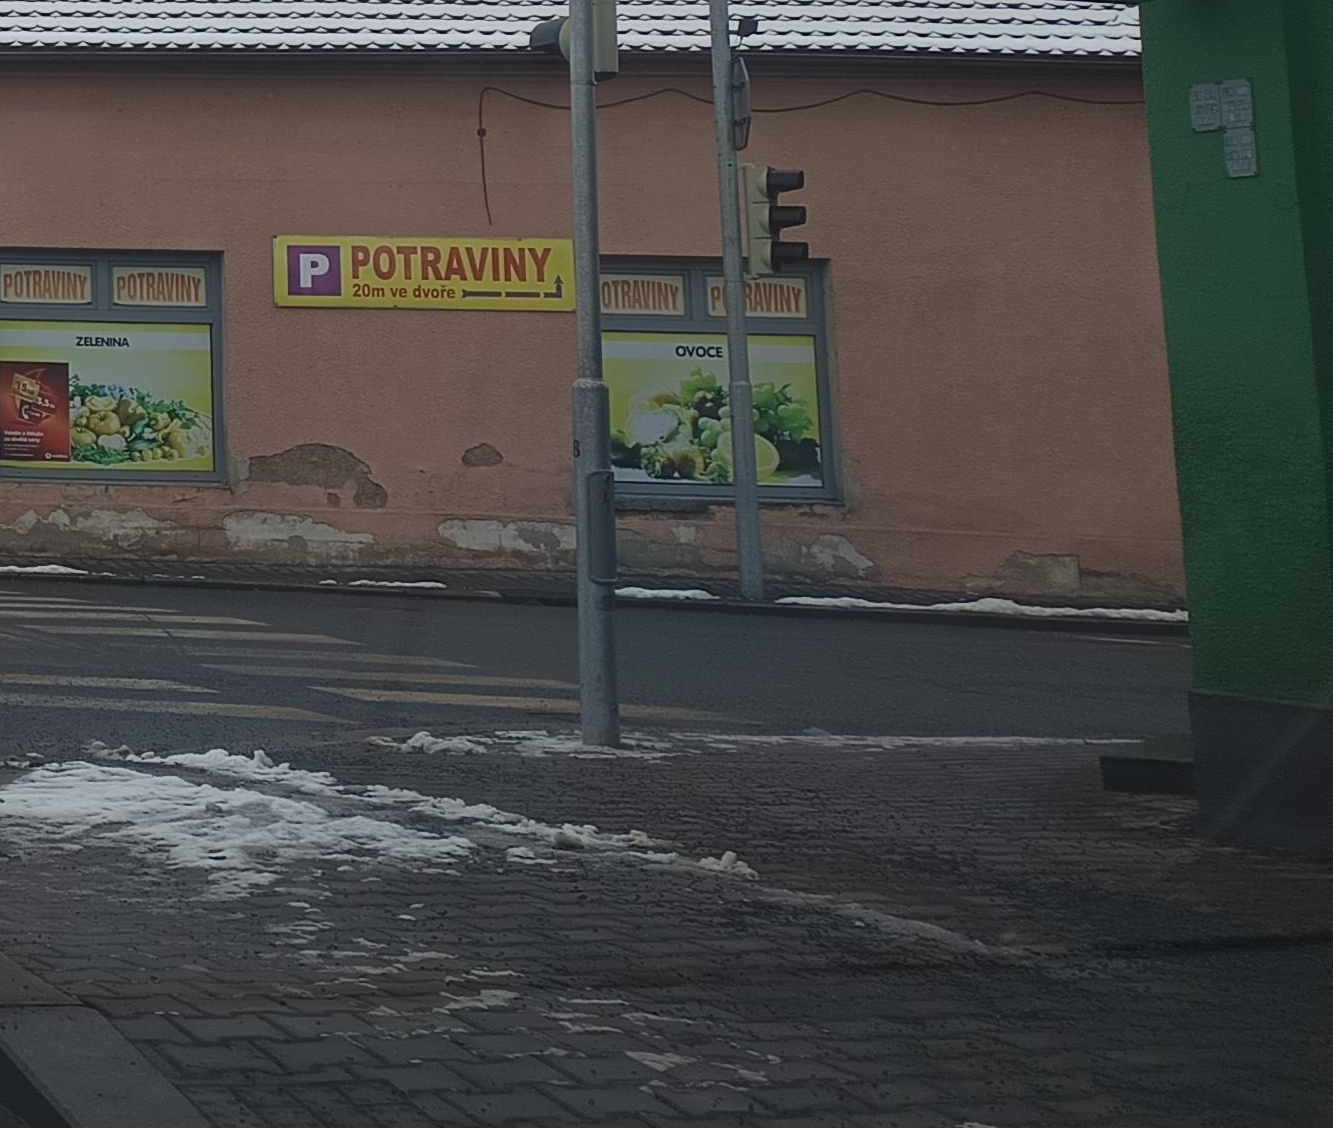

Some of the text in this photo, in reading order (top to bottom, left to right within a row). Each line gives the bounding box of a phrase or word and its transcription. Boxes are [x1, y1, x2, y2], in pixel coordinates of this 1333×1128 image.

[299, 245, 551, 288] P POTRAVINY
[3, 270, 87, 300] POTRAVINY
[117, 272, 201, 302] POTRAVINY
[352, 284, 455, 299] 20m ve dvoře
[76, 336, 130, 347] ZELENINA
[675, 345, 723, 358] OVOCE
